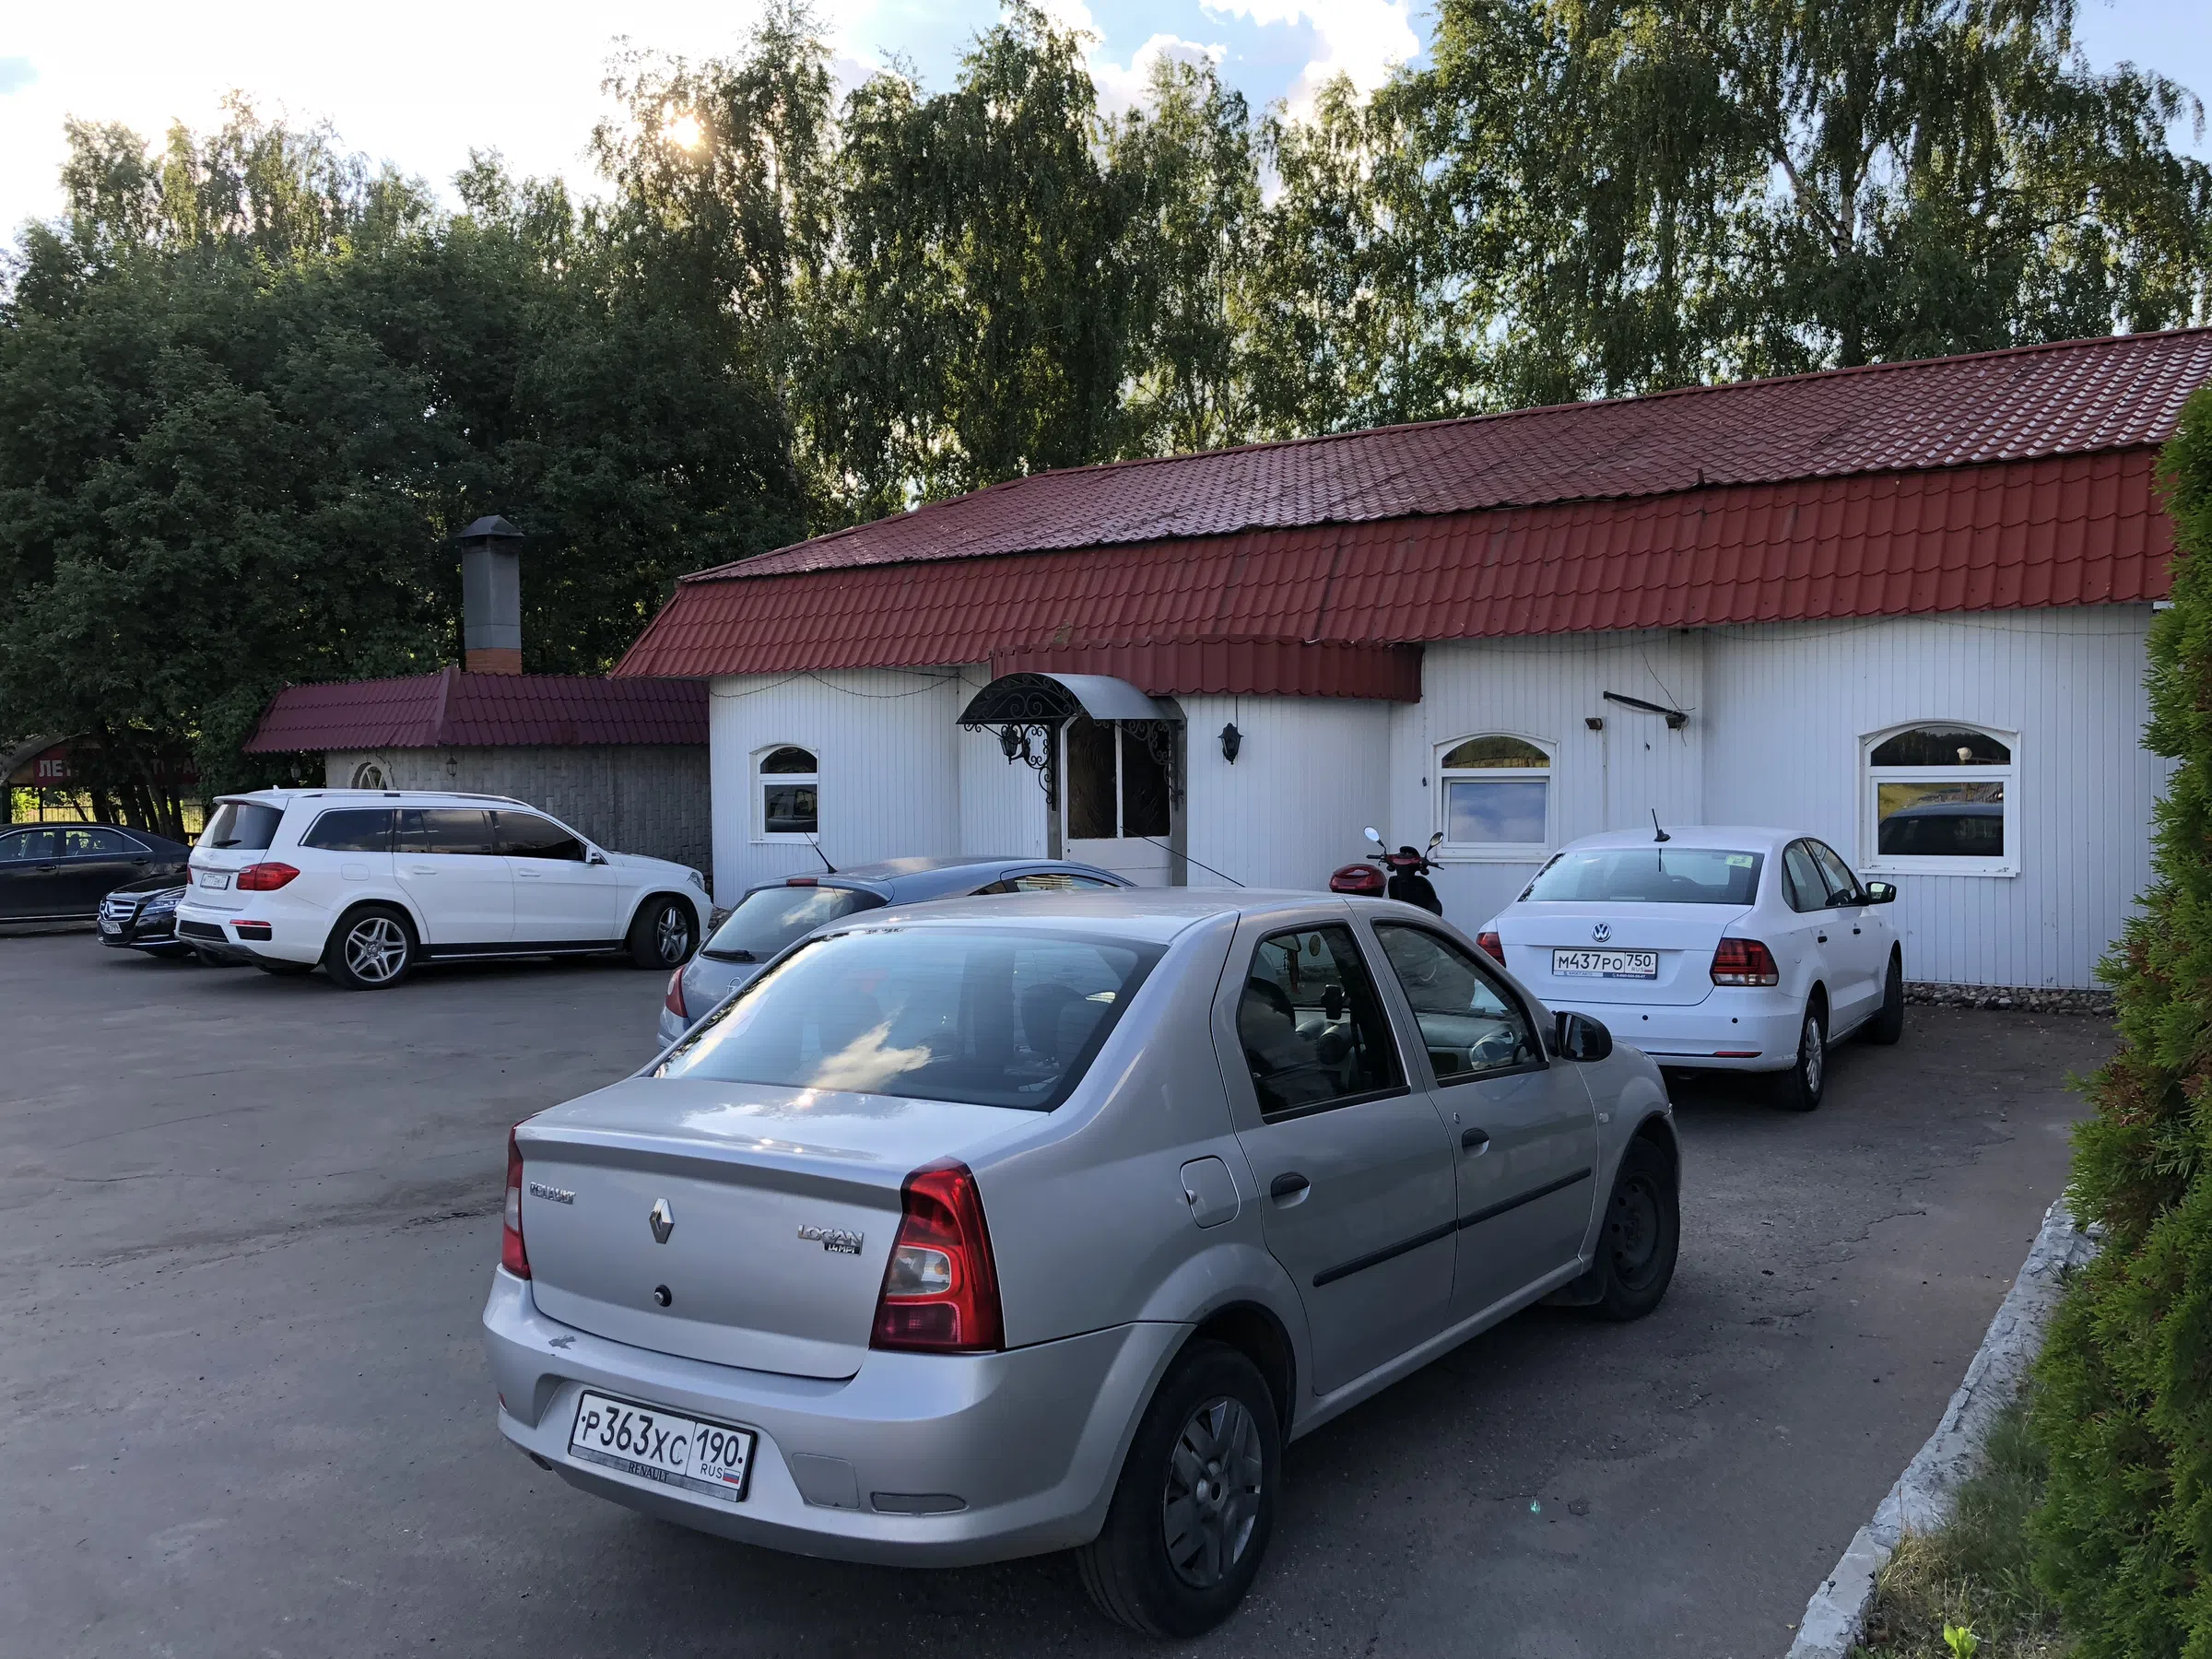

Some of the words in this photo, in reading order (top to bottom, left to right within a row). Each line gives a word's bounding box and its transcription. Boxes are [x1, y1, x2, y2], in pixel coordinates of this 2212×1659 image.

[1626, 954, 1652, 967] 750
[798, 1224, 865, 1248] LOGAN
[582, 1406, 688, 1465] Р363ХС
[696, 1429, 739, 1467] 190
[628, 1462, 669, 1483] RENAULT
[700, 1464, 723, 1479] RUS
